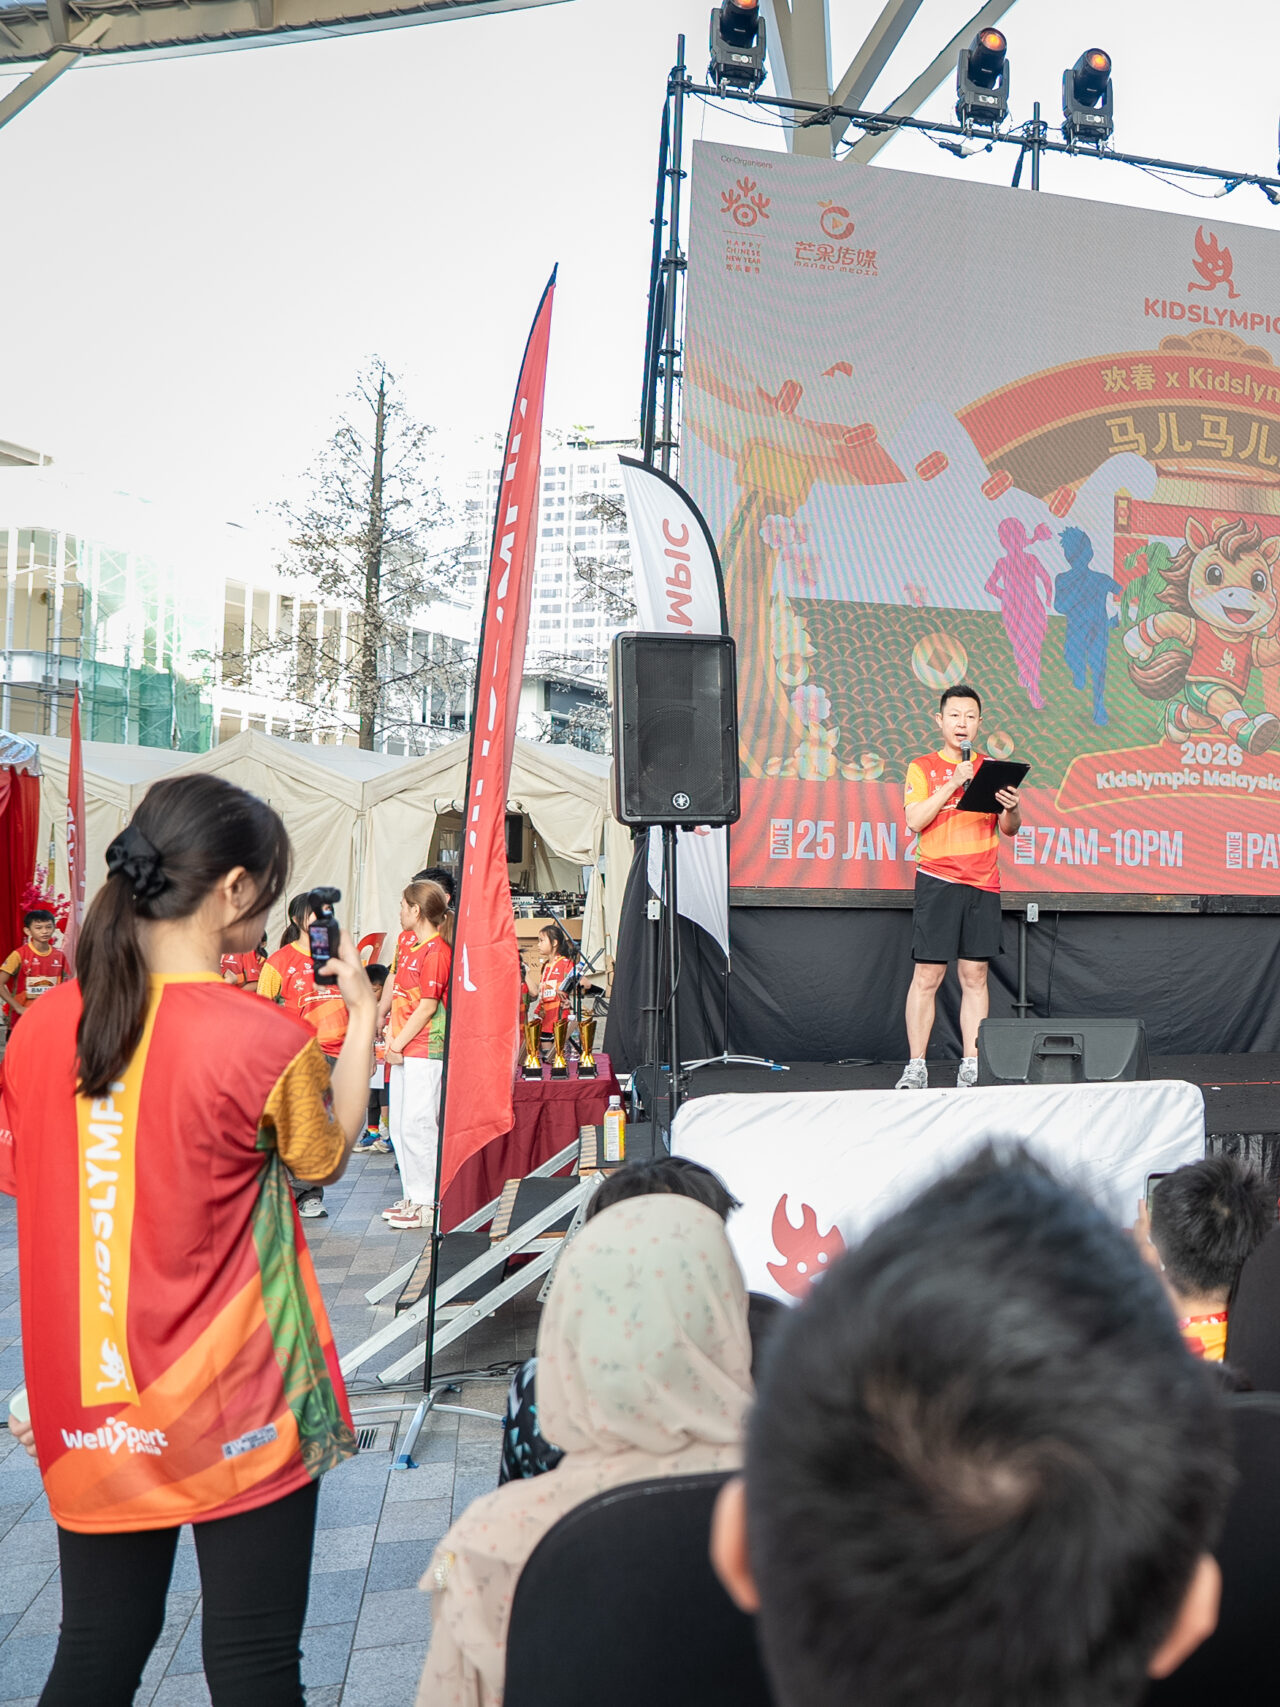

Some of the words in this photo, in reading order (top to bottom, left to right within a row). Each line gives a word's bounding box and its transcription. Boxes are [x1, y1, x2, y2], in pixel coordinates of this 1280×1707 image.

[720, 155, 773, 169] Co-Organisers
[726, 239, 761, 249] HAPPY
[726, 246, 760, 257] CHINESE
[794, 241, 879, 271] 芒果传媒
[726, 255, 742, 263] NEW
[744, 256, 761, 265] YEAR
[1101, 363, 1156, 393] 欢春
[1180, 742, 1243, 766] 2026
[1096, 768, 1201, 791] Kidslympic
[772, 823, 789, 856] DATE
[797, 820, 835, 860] 25
[841, 821, 896, 861] JAN
[1016, 830, 1033, 862] TIME
[1038, 827, 1183, 867] 7AM-10PM
[1228, 832, 1241, 867] VENUE
[86, 1082, 125, 1316] KIDSLYMP
